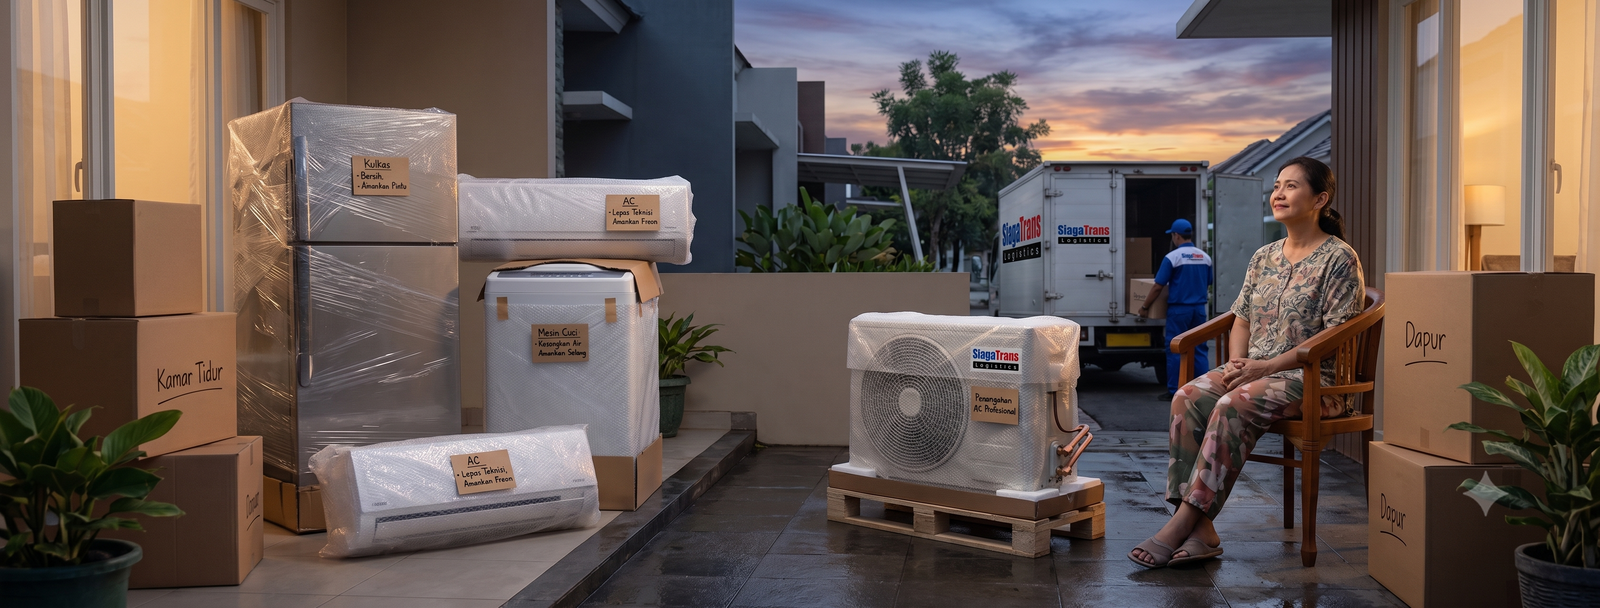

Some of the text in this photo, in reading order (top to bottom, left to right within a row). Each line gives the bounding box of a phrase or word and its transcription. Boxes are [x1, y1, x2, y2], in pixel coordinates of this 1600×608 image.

[364, 158, 391, 169] Kulkas
[360, 171, 384, 180] Bersih,
[391, 181, 407, 190] Pintu
[622, 196, 635, 205] AC
[612, 208, 653, 218] Lepas Teknisi
[612, 217, 658, 225] Amankan Freon
[1002, 214, 1042, 247] SiagaTrans
[1057, 224, 1110, 237] SiagaTrans
[1003, 246, 1040, 262] Logistics
[537, 327, 560, 337] Mesin
[572, 339, 582, 347] Air
[1405, 320, 1447, 358] Dapur
[538, 348, 587, 359] Amankan Selang
[972, 348, 1020, 362] SiagaTrans
[974, 362, 1018, 370] Logistics
[157, 359, 224, 393] Kamar Tidur
[973, 404, 1017, 416] AC Profesional
[467, 455, 481, 466] AC
[460, 470, 482, 480] Lepas
[463, 475, 514, 488] Amankan Freon
[1380, 492, 1407, 533] Dapur
